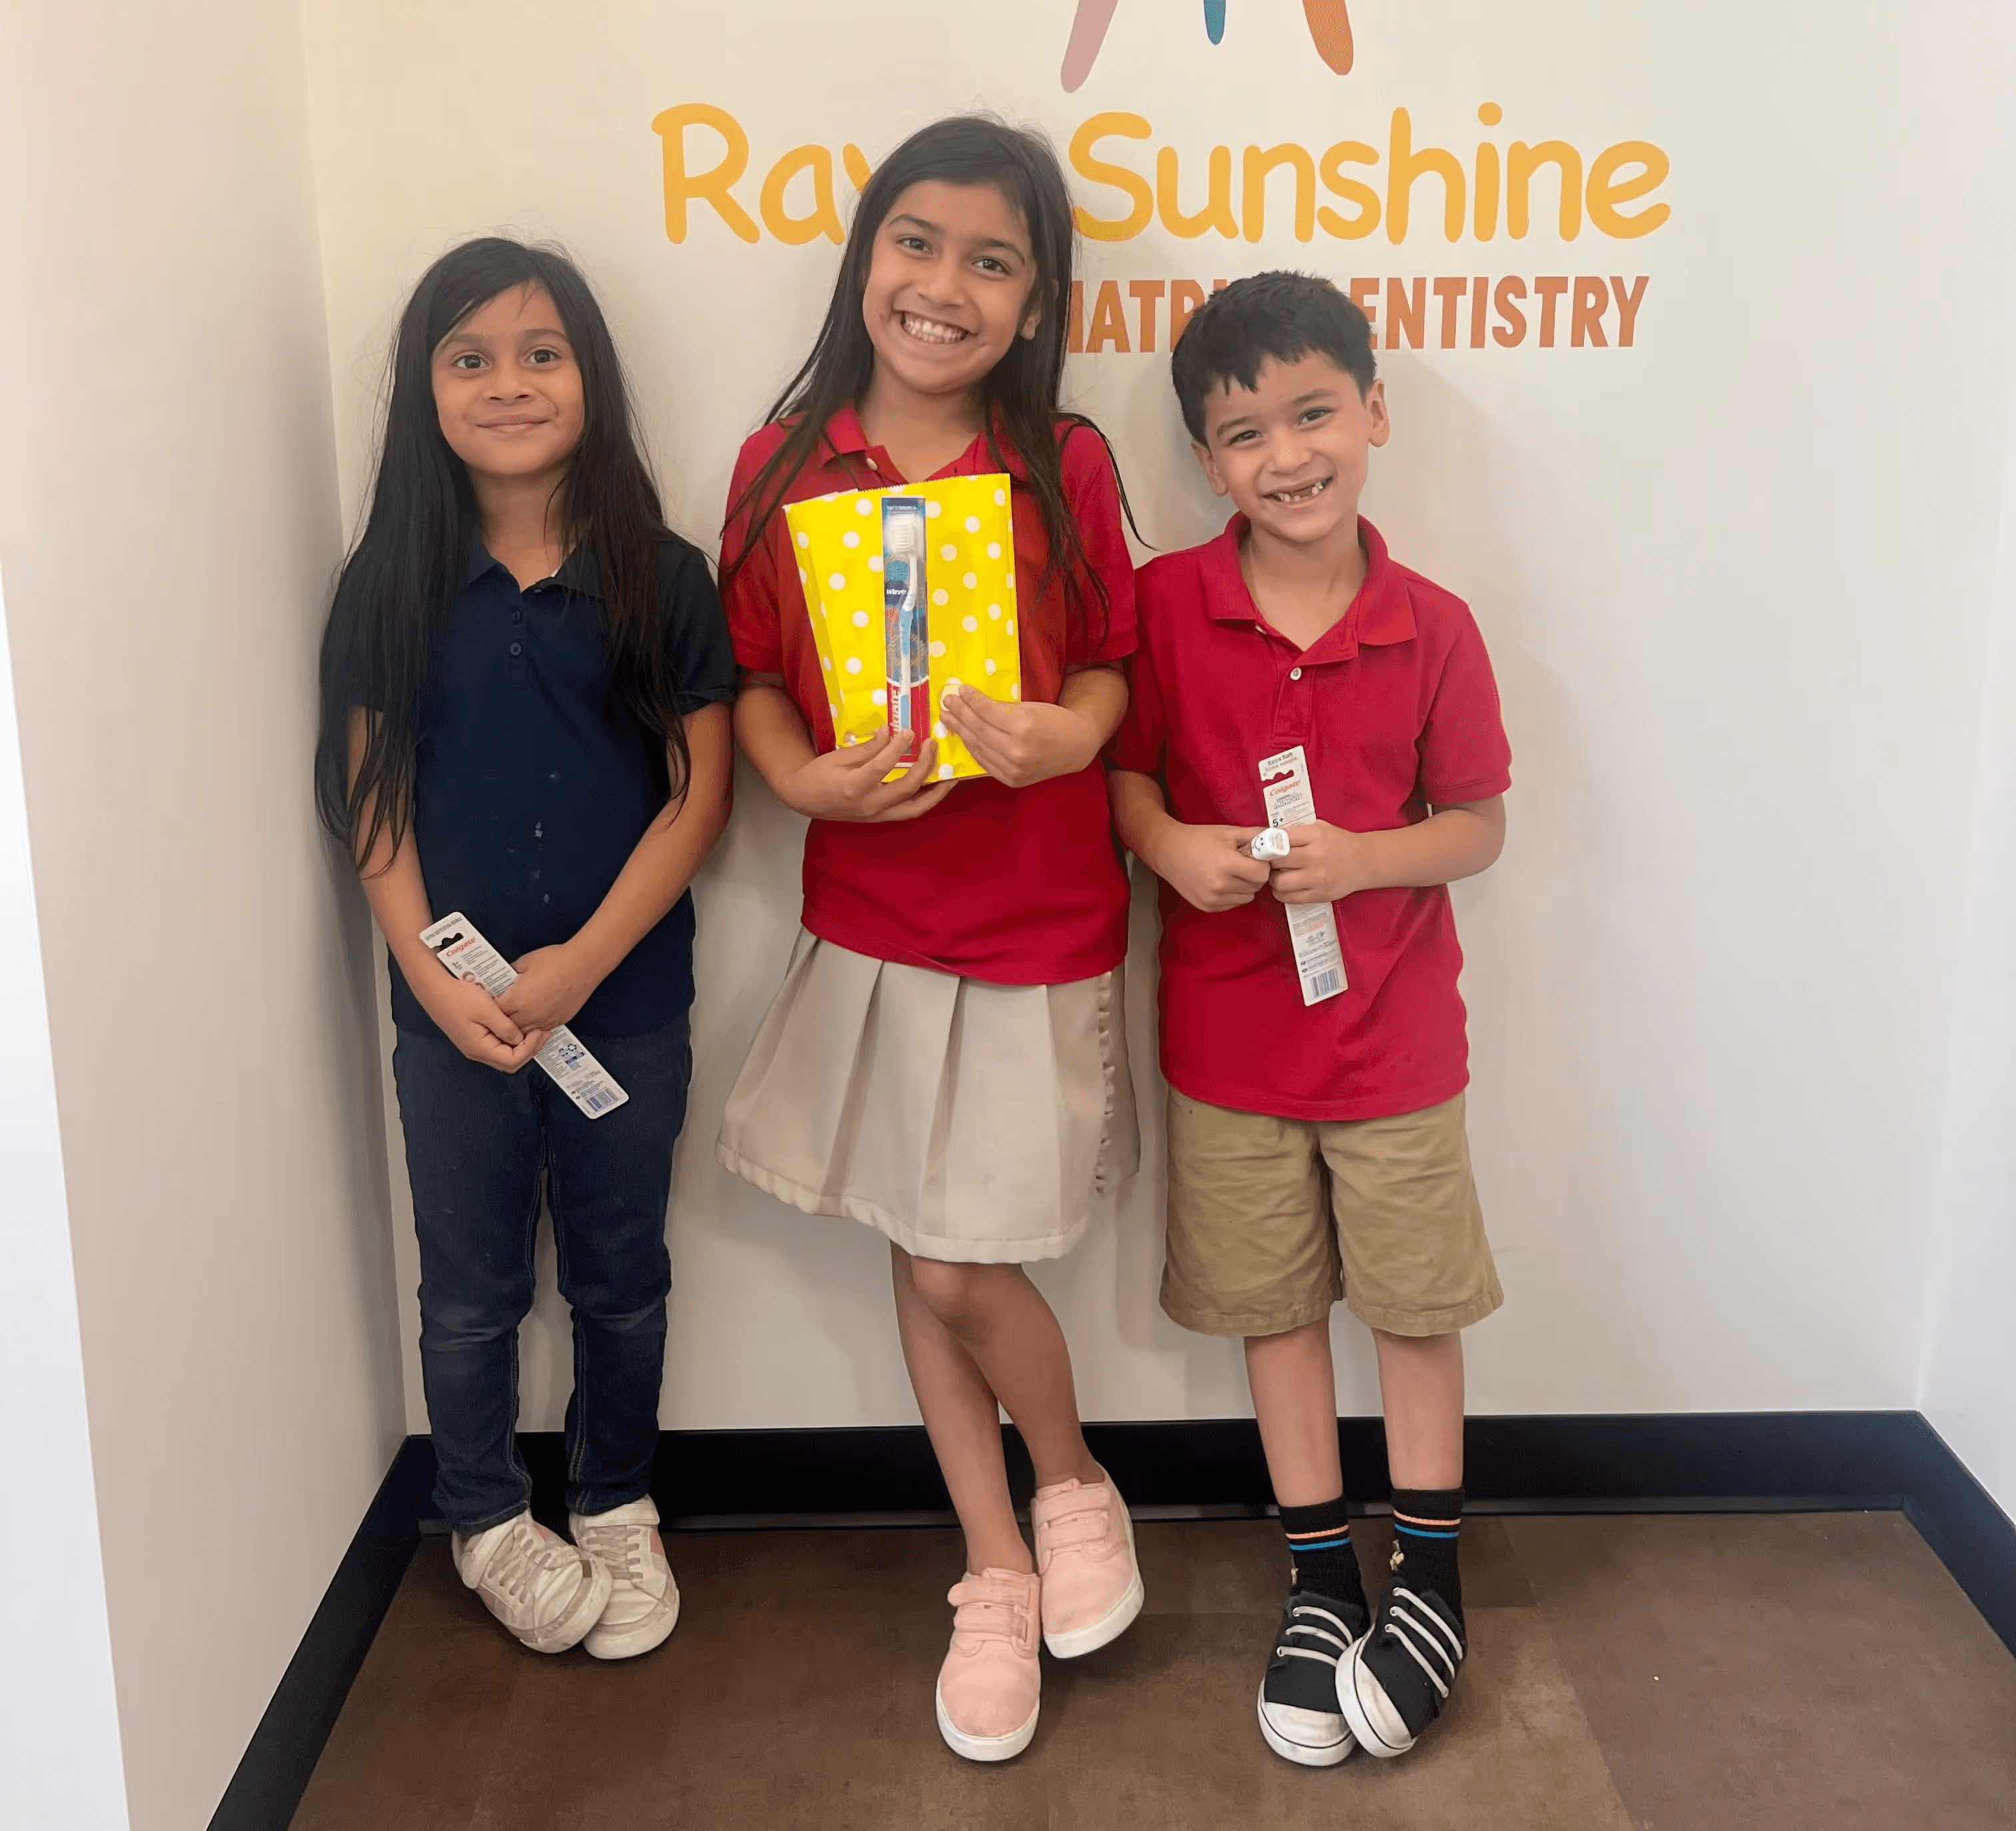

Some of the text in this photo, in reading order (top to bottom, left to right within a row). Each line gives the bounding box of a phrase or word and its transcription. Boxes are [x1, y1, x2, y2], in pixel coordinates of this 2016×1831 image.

[1068, 101, 1671, 245] Sunshine
[1345, 275, 1650, 351] ENTISTRY
[1269, 779, 1301, 797] Colgate
[446, 936, 476, 957] Colgate
